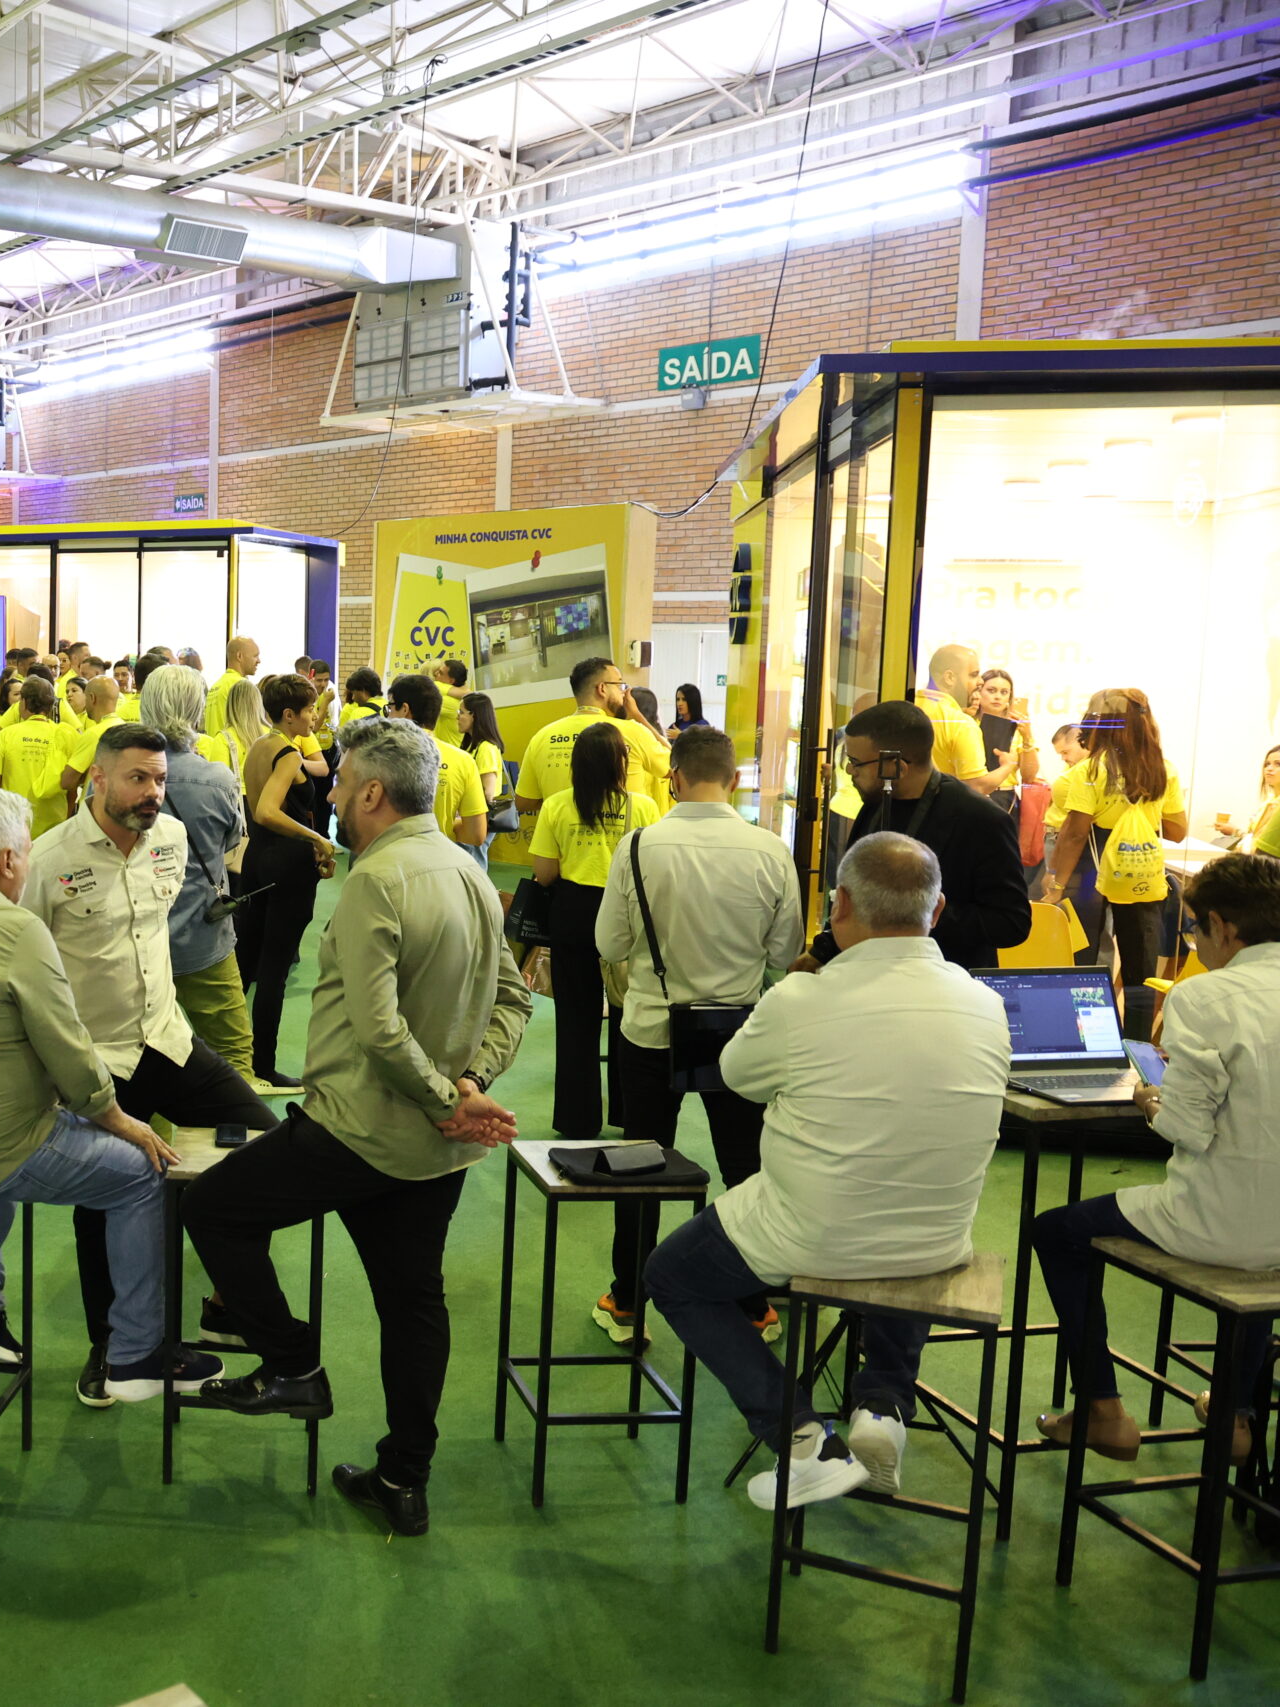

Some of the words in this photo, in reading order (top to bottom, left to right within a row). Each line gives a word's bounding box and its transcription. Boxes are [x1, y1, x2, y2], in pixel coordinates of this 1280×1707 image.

[663, 346, 754, 385] SAÍDA
[181, 496, 204, 510] SAÍDA
[435, 534, 468, 545] MINHA
[470, 529, 529, 542] CONQUISTA
[531, 527, 552, 539] CVC
[410, 626, 455, 647] CVC
[550, 734, 570, 743] São
